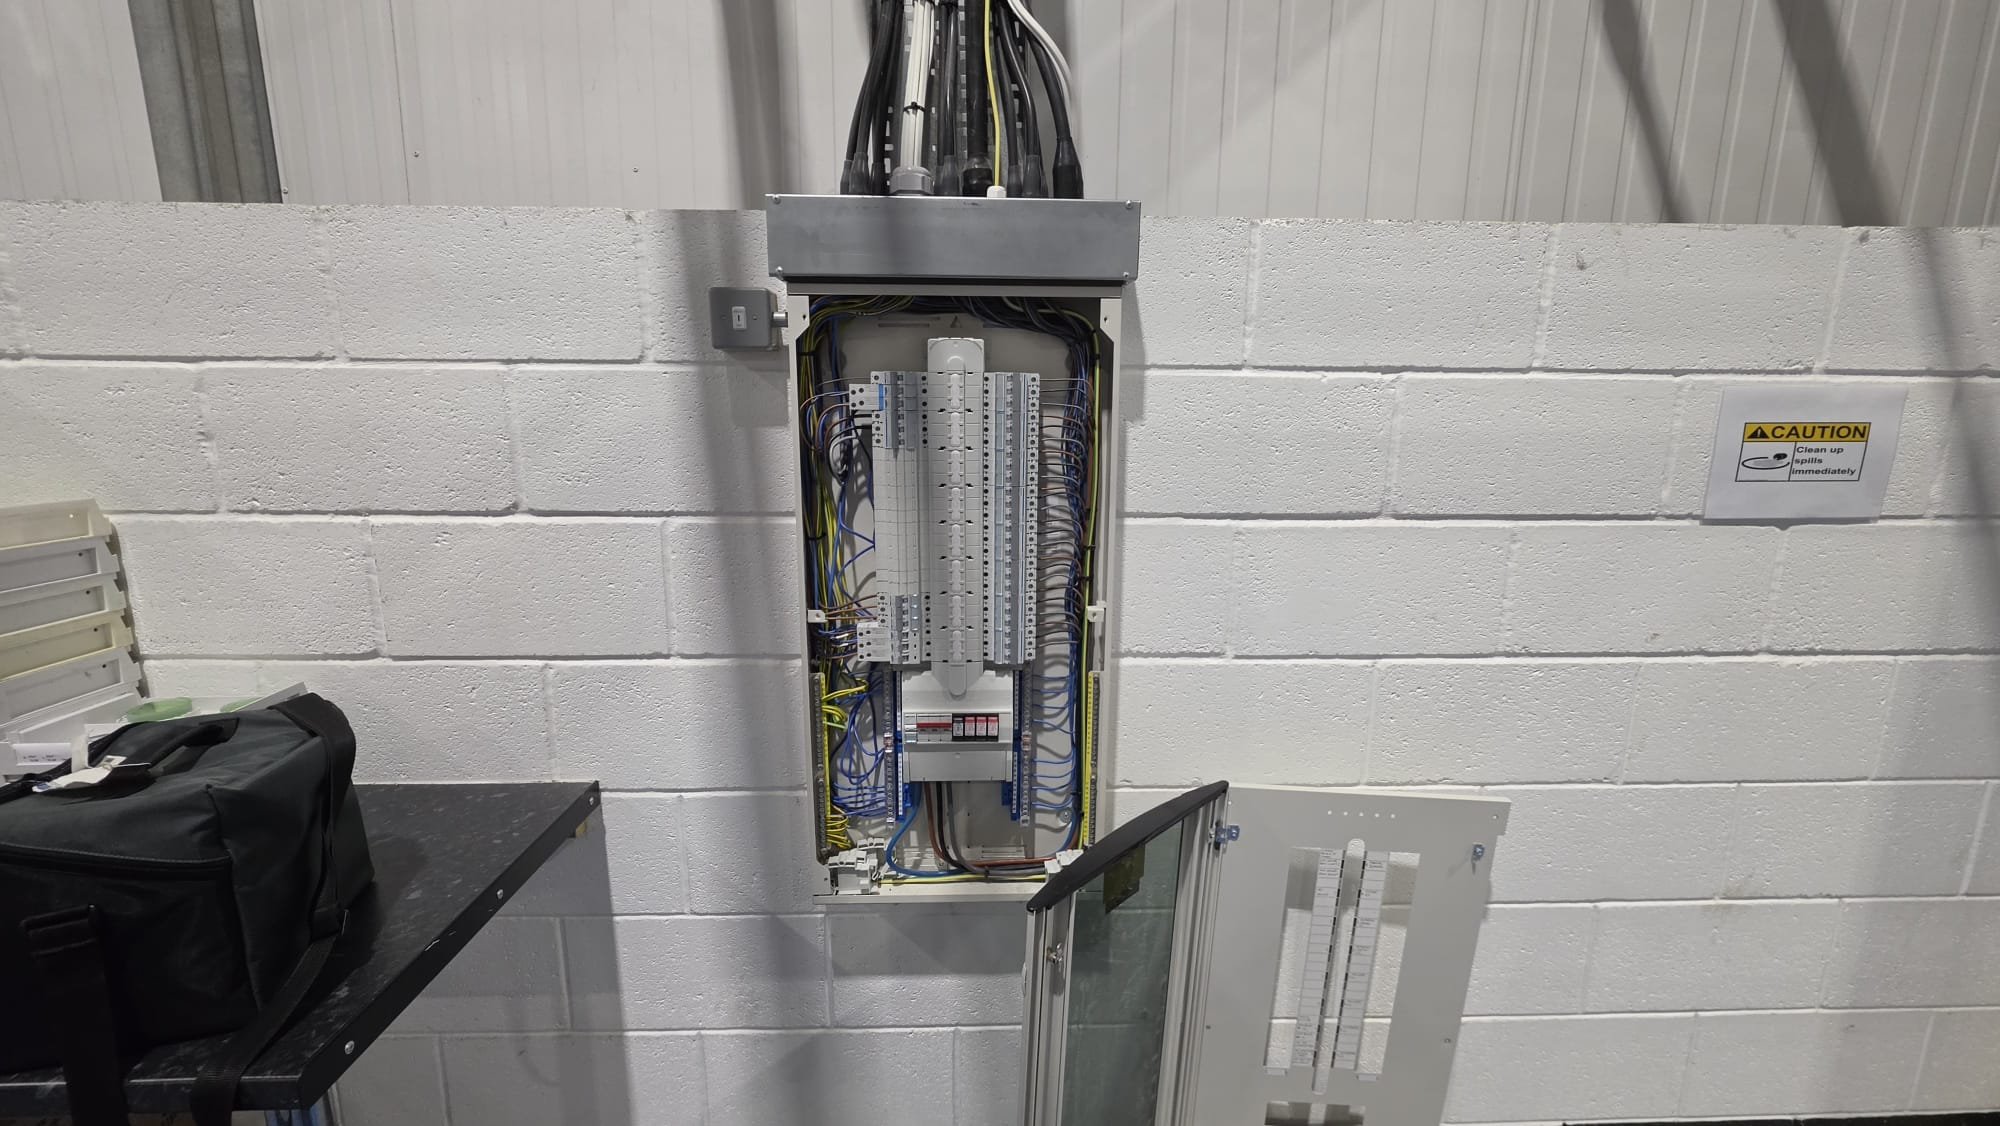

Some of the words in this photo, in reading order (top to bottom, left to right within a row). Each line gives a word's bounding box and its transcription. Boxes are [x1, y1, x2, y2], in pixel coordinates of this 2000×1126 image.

[1771, 425, 1867, 439] CAUTION
[1796, 446, 1827, 454] Clean
[1830, 447, 1844, 455] up
[1794, 457, 1823, 465] spills
[1791, 467, 1857, 476] immediately
